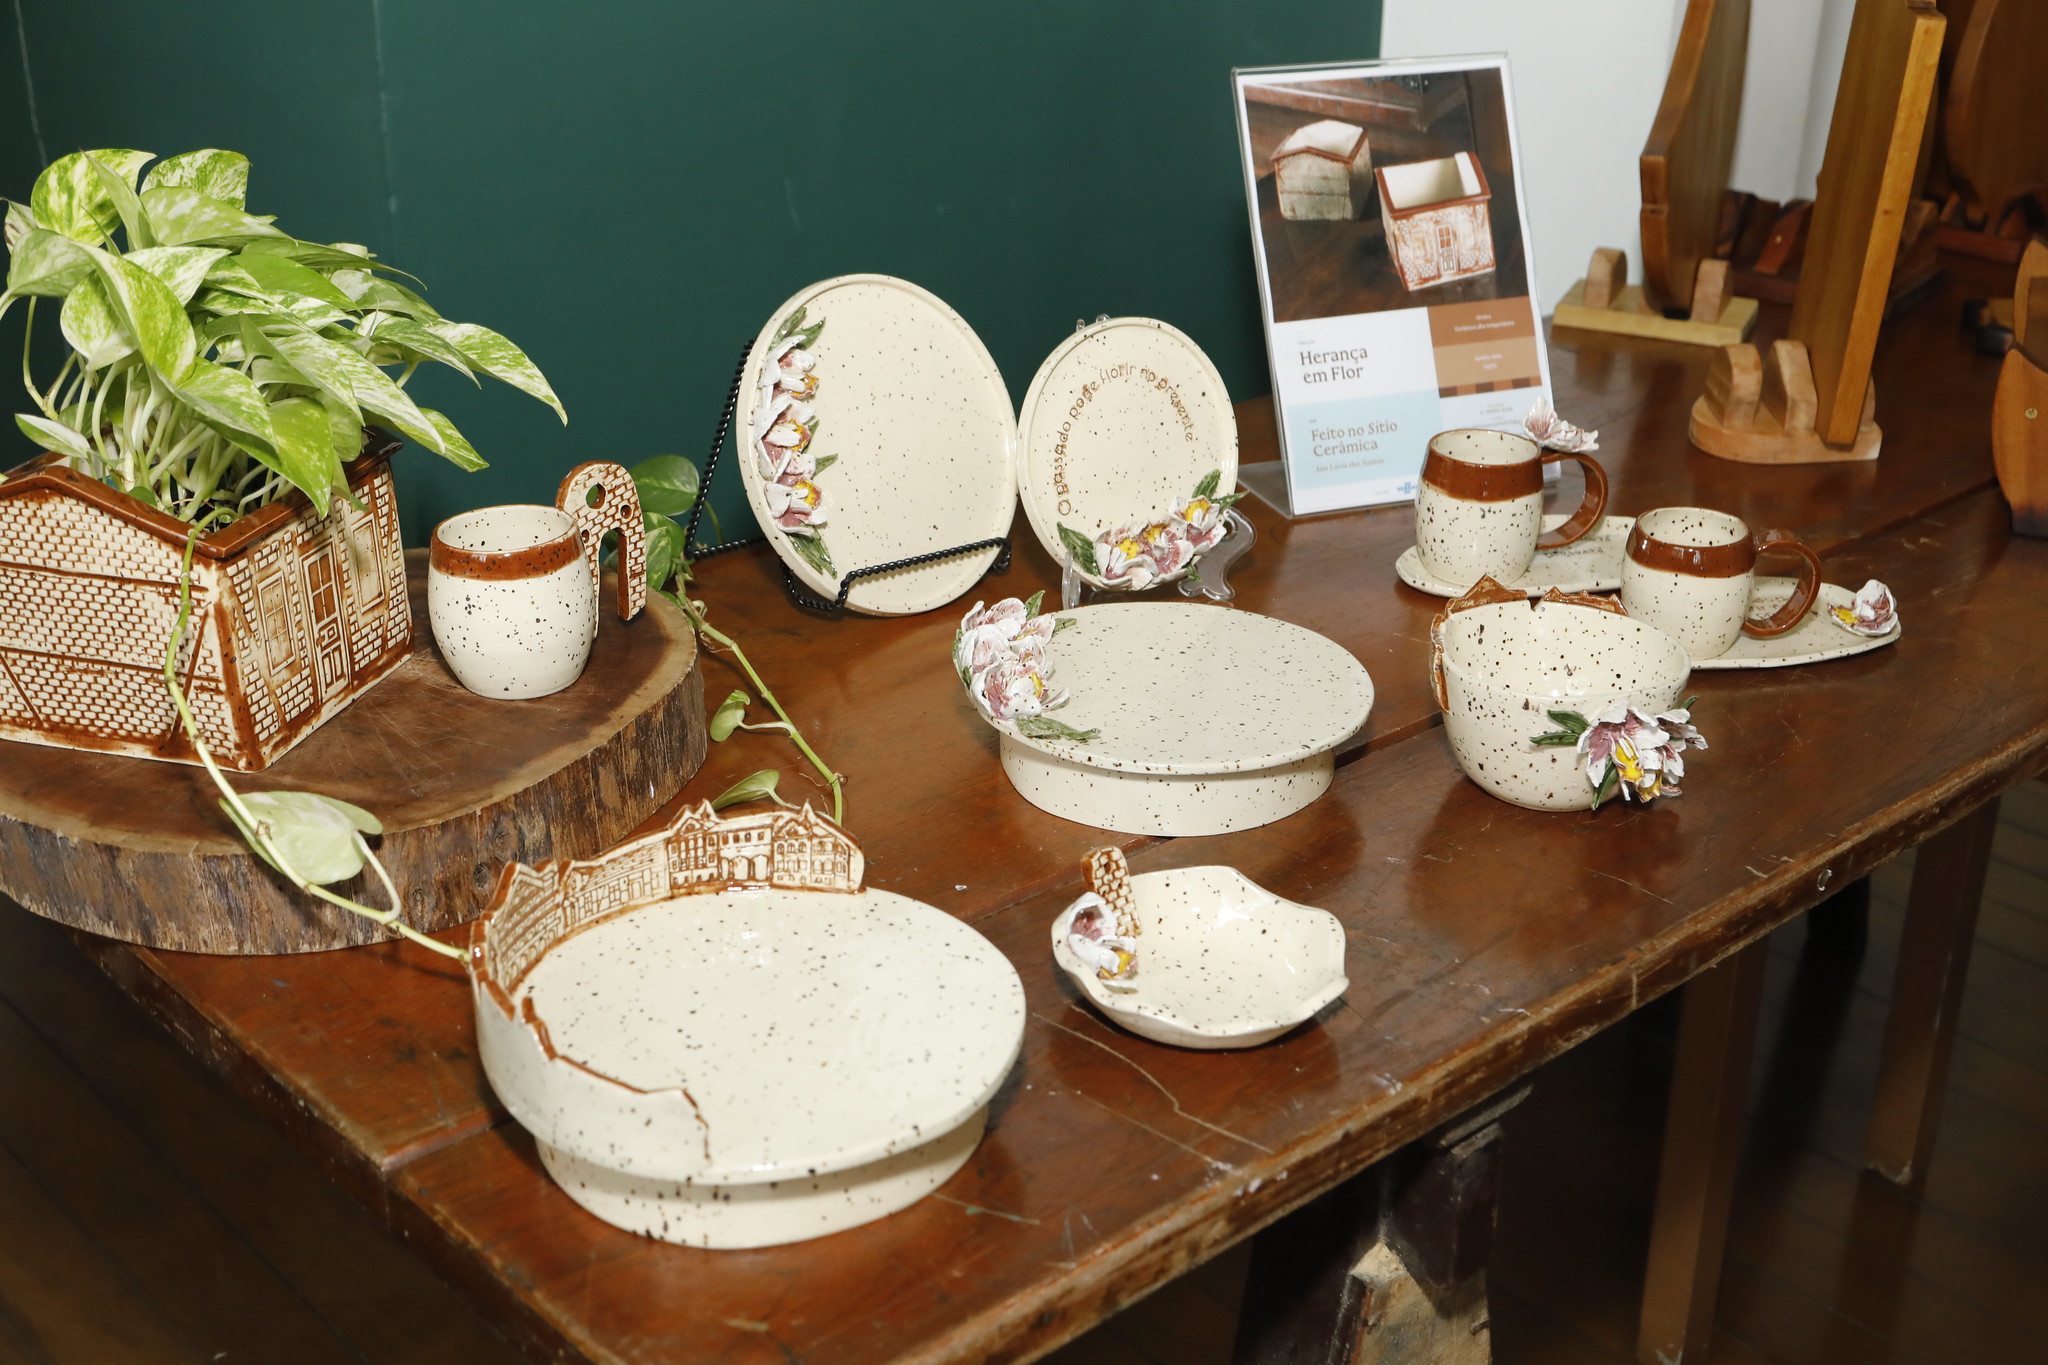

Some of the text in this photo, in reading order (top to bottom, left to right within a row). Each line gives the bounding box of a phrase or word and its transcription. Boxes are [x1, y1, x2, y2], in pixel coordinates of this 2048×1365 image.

[1300, 347, 1368, 365] Herança
[1140, 368, 1157, 382] no
[1303, 365, 1364, 384] em Flor
[1069, 381, 1100, 420] pode
[1154, 377, 1194, 443] presente
[1311, 427, 1345, 442] Feito
[1348, 426, 1365, 438] no
[1313, 439, 1378, 457] Cerâmica
[1053, 421, 1072, 497] passado
[1058, 499, 1072, 516] O
